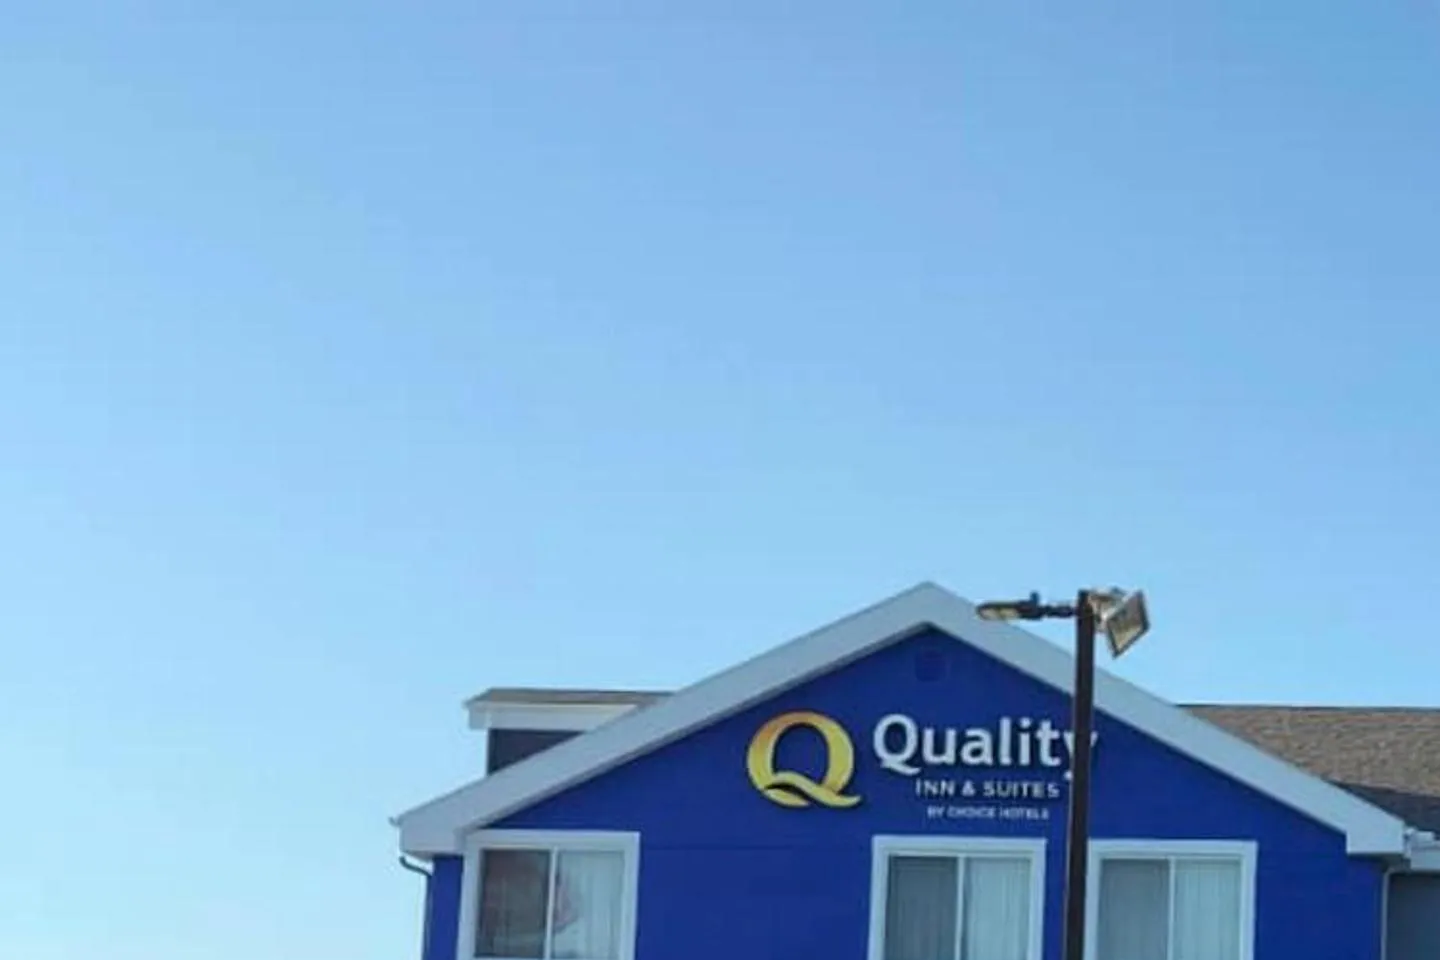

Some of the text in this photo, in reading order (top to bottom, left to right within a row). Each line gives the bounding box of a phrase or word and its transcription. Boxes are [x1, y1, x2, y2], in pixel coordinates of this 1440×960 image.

[746, 710, 862, 808] Q
[915, 779, 1060, 798] INN & SUITES
[926, 804, 945, 819] BY
[948, 804, 996, 820] CHOICE
